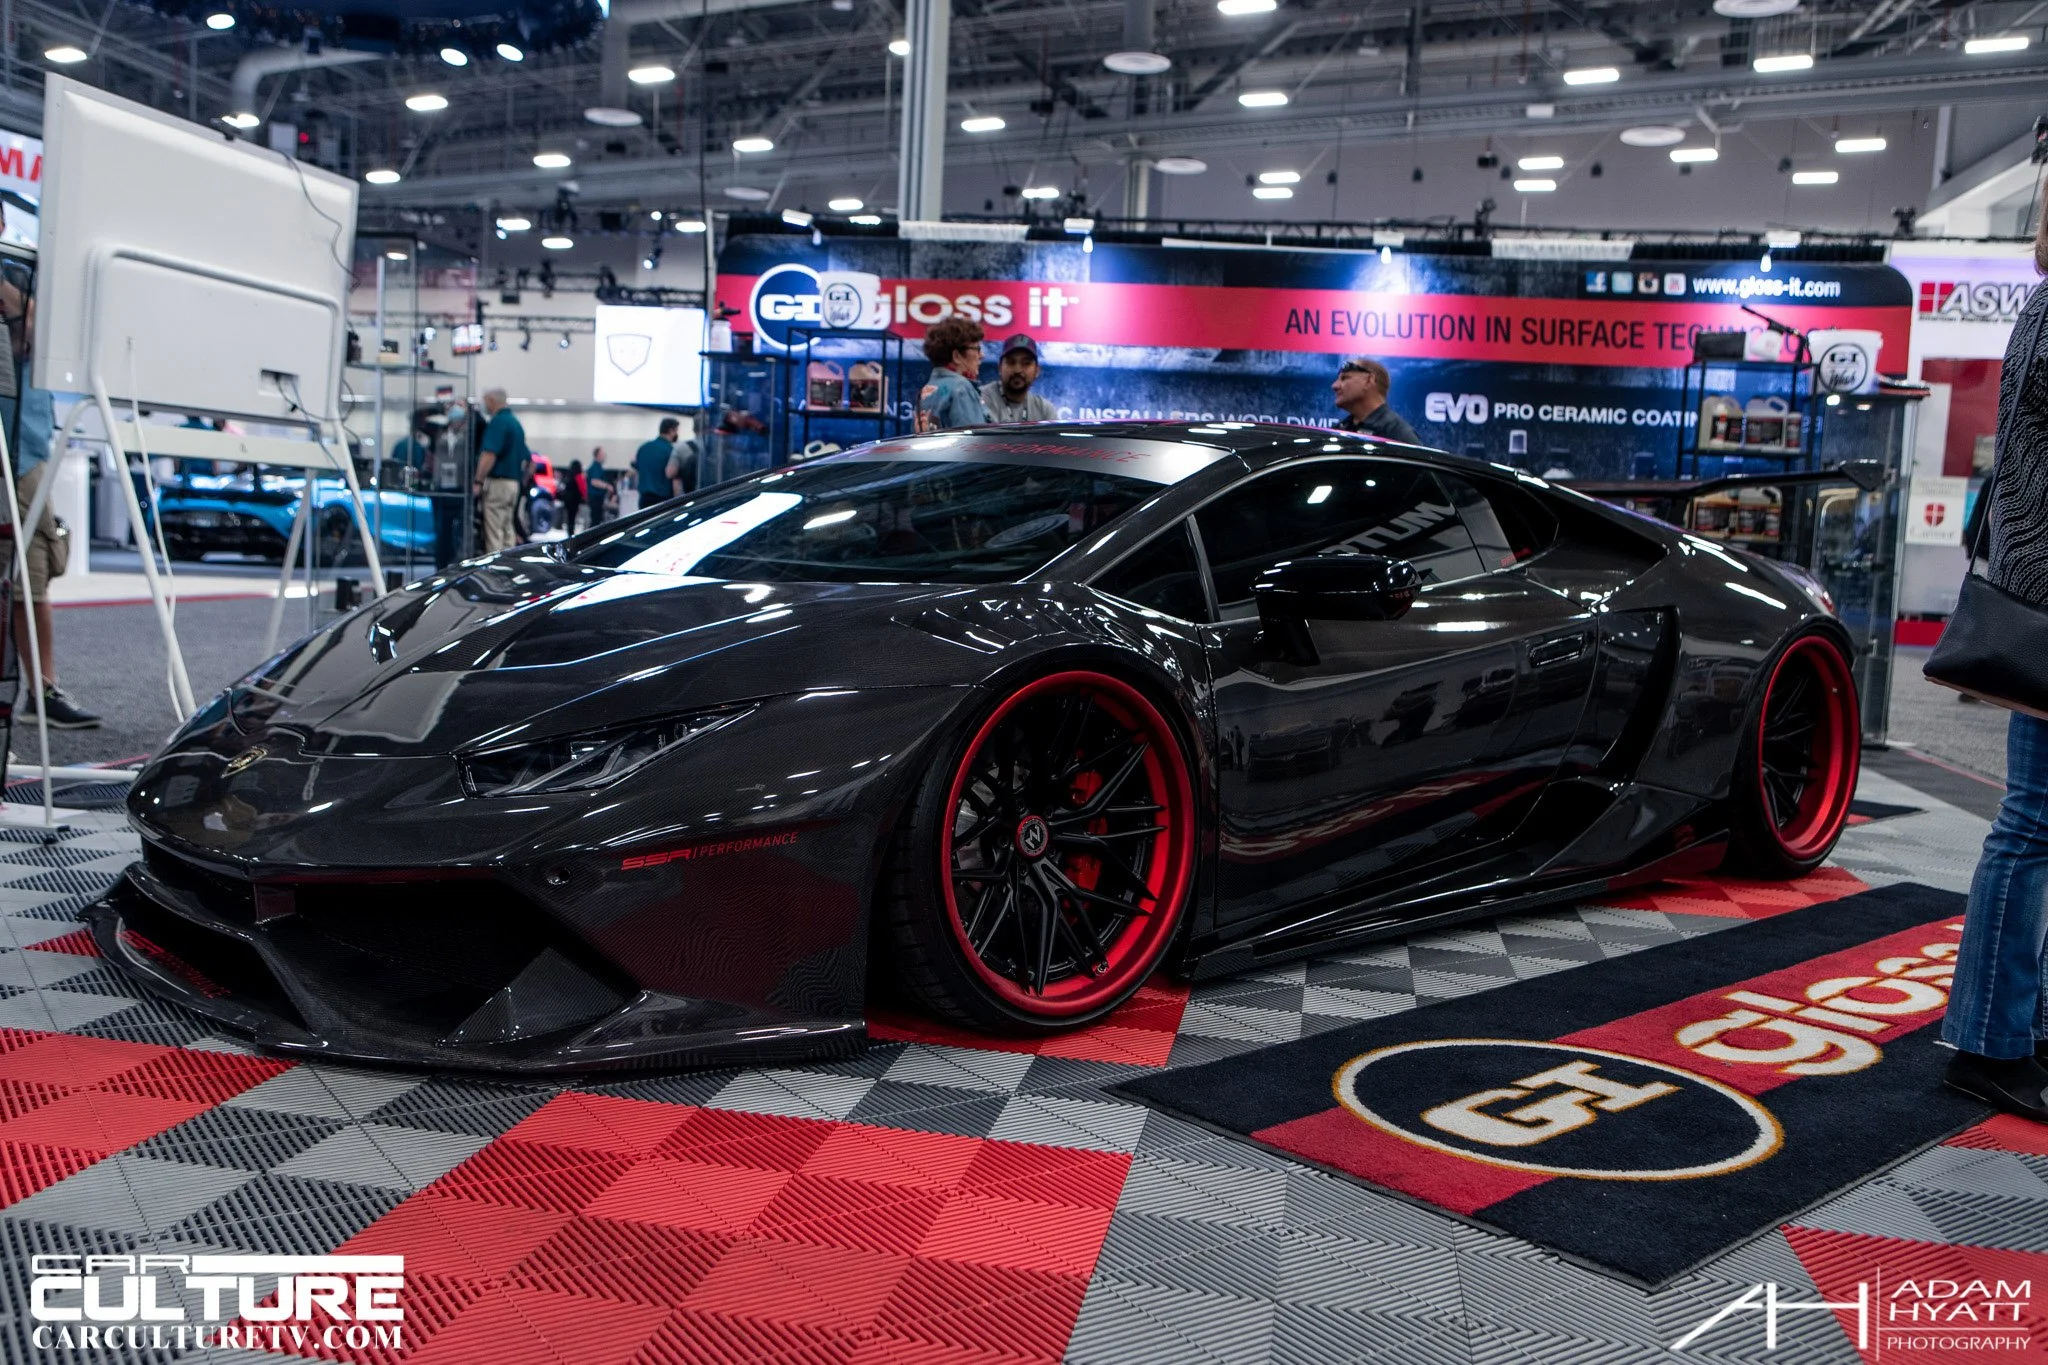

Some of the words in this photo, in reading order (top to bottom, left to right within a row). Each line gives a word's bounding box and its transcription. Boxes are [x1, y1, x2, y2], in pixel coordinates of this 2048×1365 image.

[1692, 276, 1841, 299] www.gloss-it.com
[1284, 308, 1321, 335] AN
[1331, 310, 1475, 342] EVOLUTION
[1485, 316, 1512, 344] IN
[1521, 317, 1645, 349] SURFACE
[1424, 391, 1489, 425] EVO
[1494, 402, 1535, 421] PRO
[1538, 405, 1628, 426] CERAMIC
[620, 848, 692, 871] SSR
[698, 831, 799, 857] PERFORMANCE
[1420, 1059, 1684, 1147] GI
